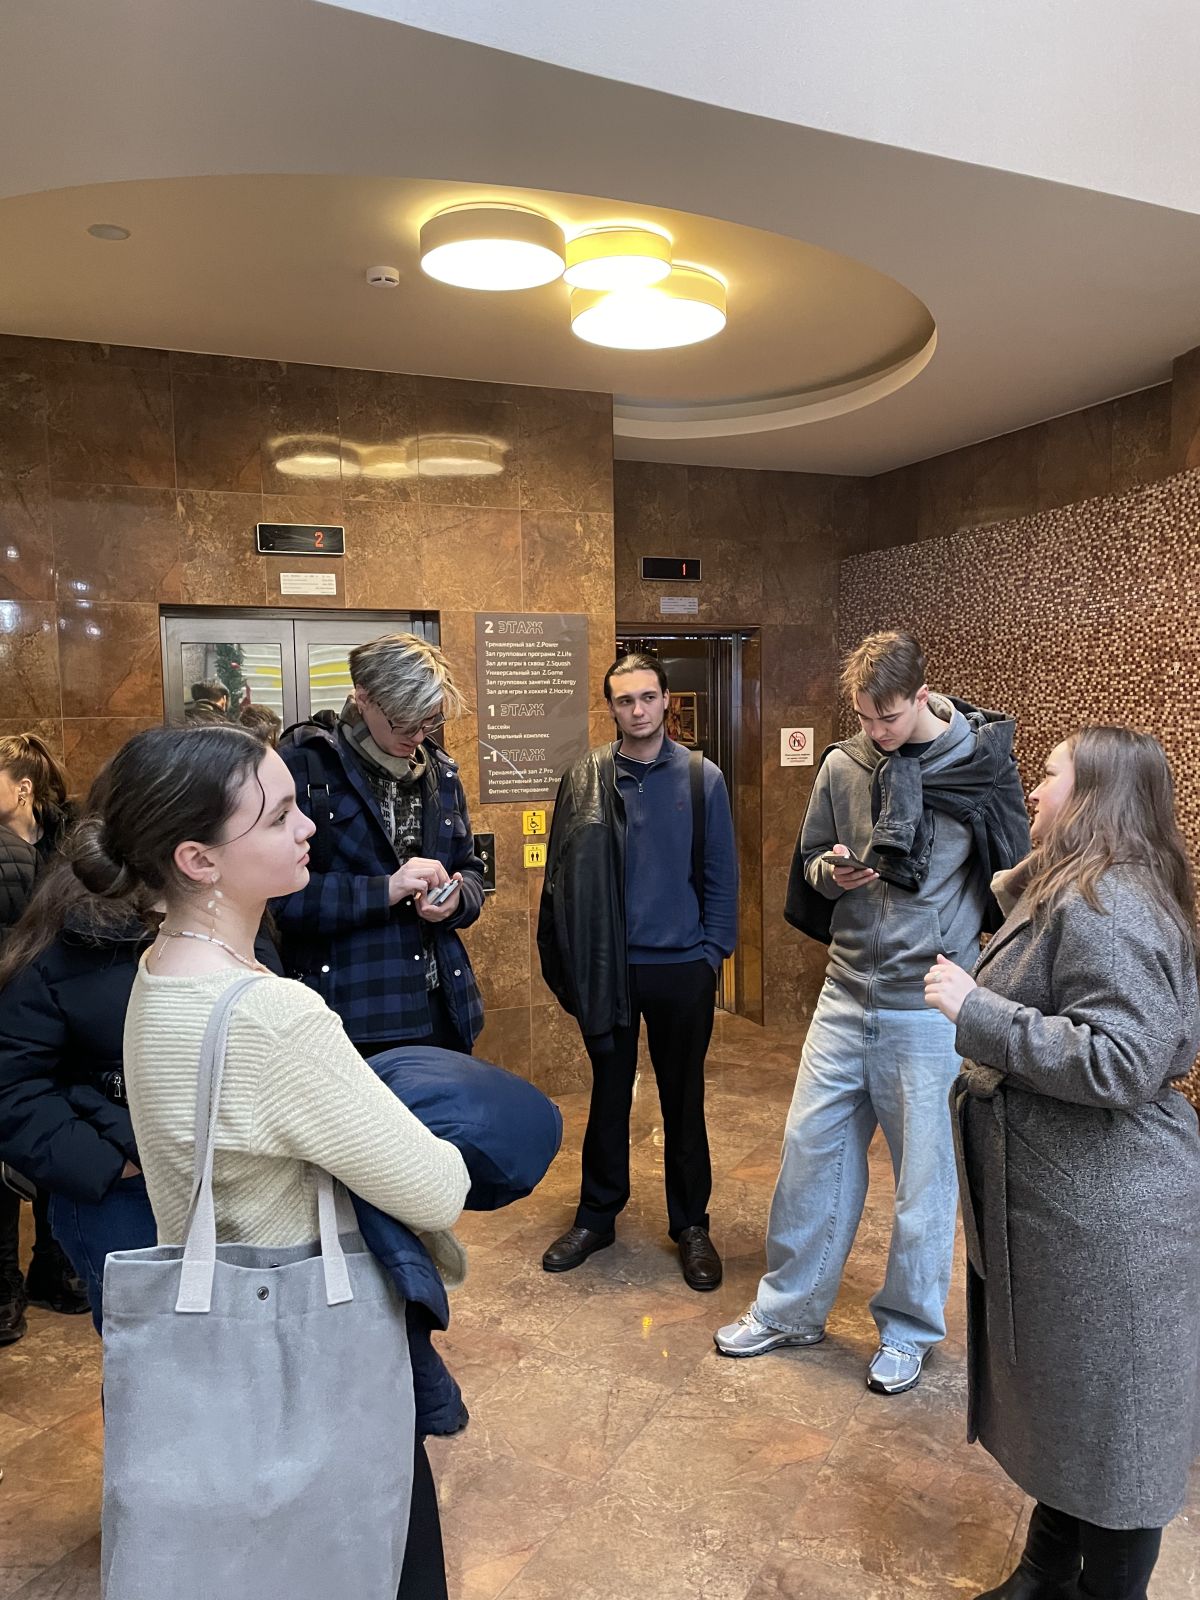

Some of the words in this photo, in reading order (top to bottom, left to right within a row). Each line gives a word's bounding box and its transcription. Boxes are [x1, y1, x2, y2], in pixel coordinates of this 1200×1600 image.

[314, 532, 324, 548] 2
[682, 563, 686, 576] 1
[484, 621, 494, 634] 2
[498, 620, 544, 634] ЭТАЖ
[488, 704, 494, 716] 1
[500, 704, 544, 716] ЭТАЖ
[484, 750, 497, 762] -1
[502, 748, 546, 762] ЭТАЖ
